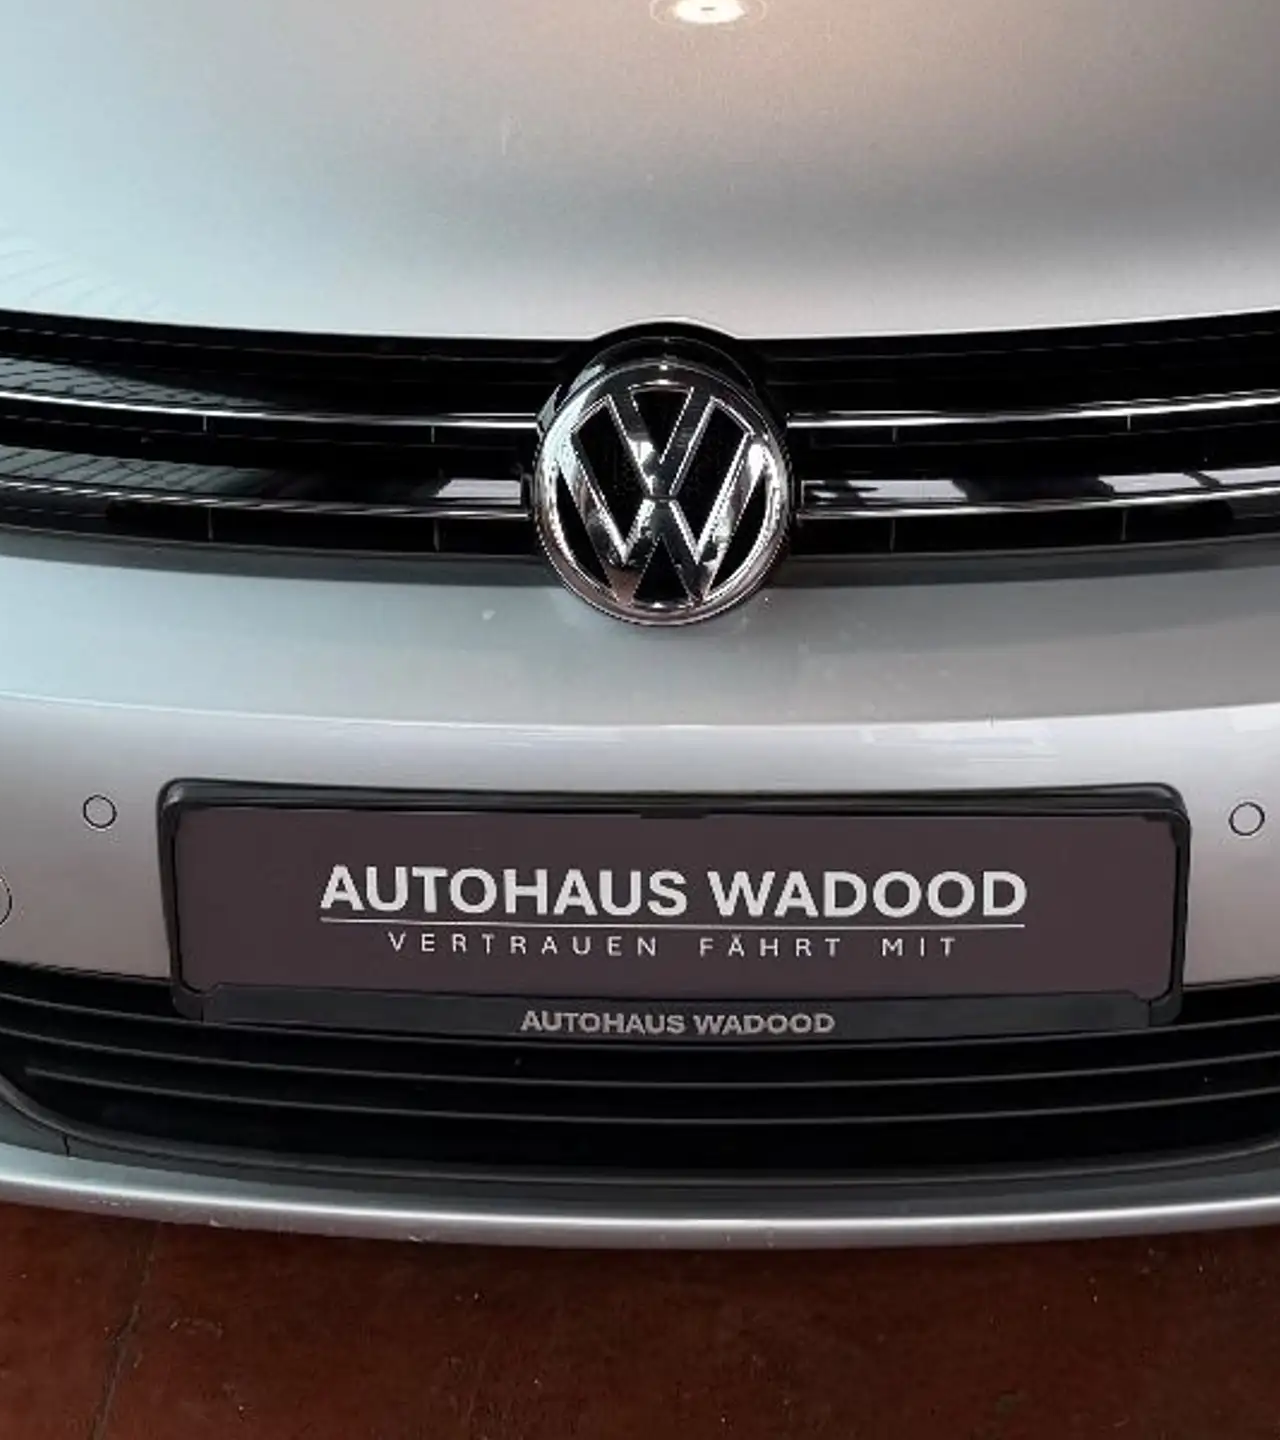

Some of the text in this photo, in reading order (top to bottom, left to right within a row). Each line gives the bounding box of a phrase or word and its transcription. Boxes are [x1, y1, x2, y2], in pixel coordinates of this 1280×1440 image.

[320, 864, 1028, 918] AUTOHAUS WADOOD
[387, 931, 956, 958] VERTRAUEN FÄHRT MIT
[521, 1010, 836, 1035] AUTOHAUS WADOOD
